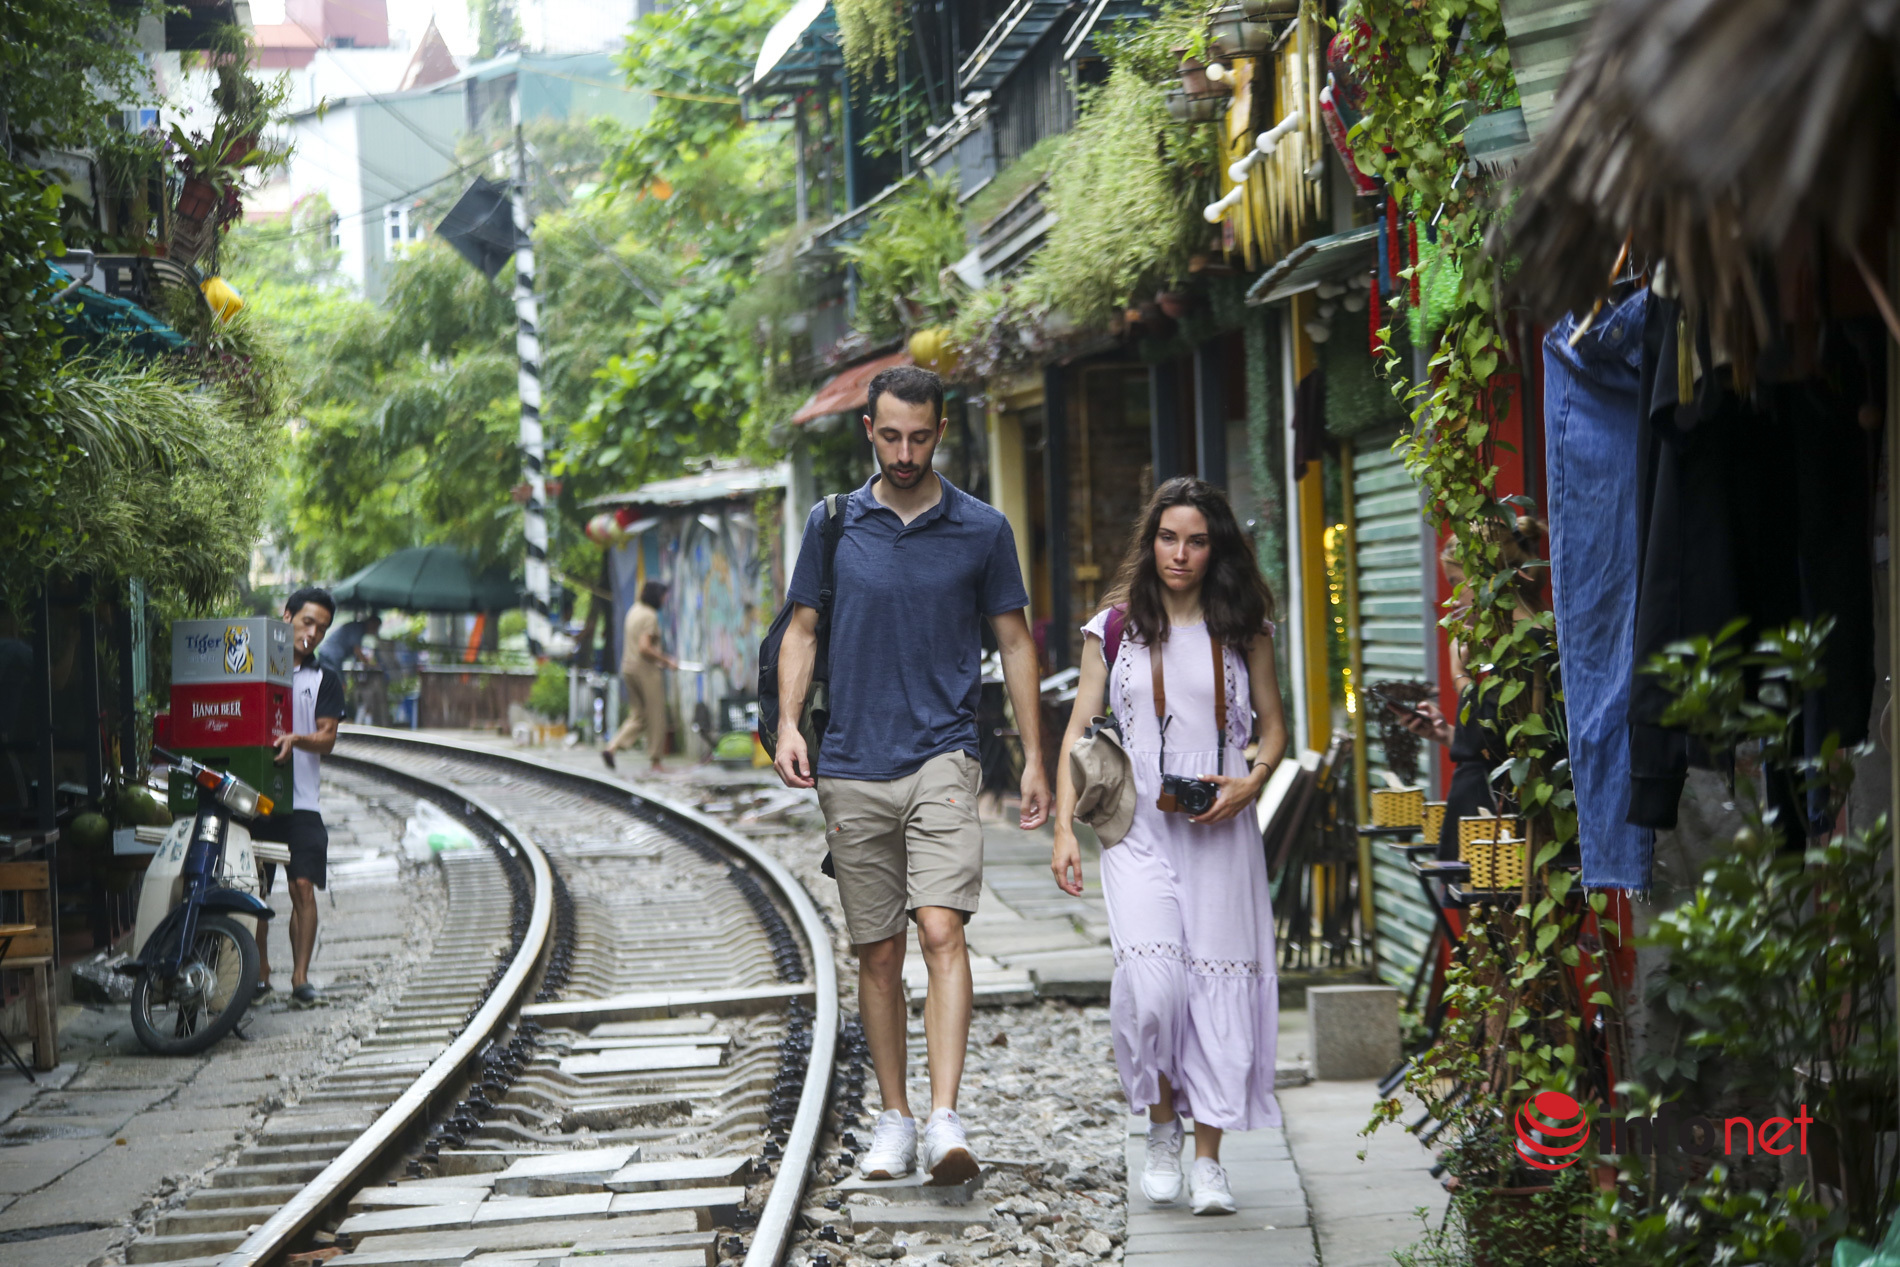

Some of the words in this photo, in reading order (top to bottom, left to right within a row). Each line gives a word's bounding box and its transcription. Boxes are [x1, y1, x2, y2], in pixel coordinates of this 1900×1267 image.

[185, 633, 222, 654] Tiger
[192, 701, 219, 718] HANOI
[220, 700, 241, 717] BEER
